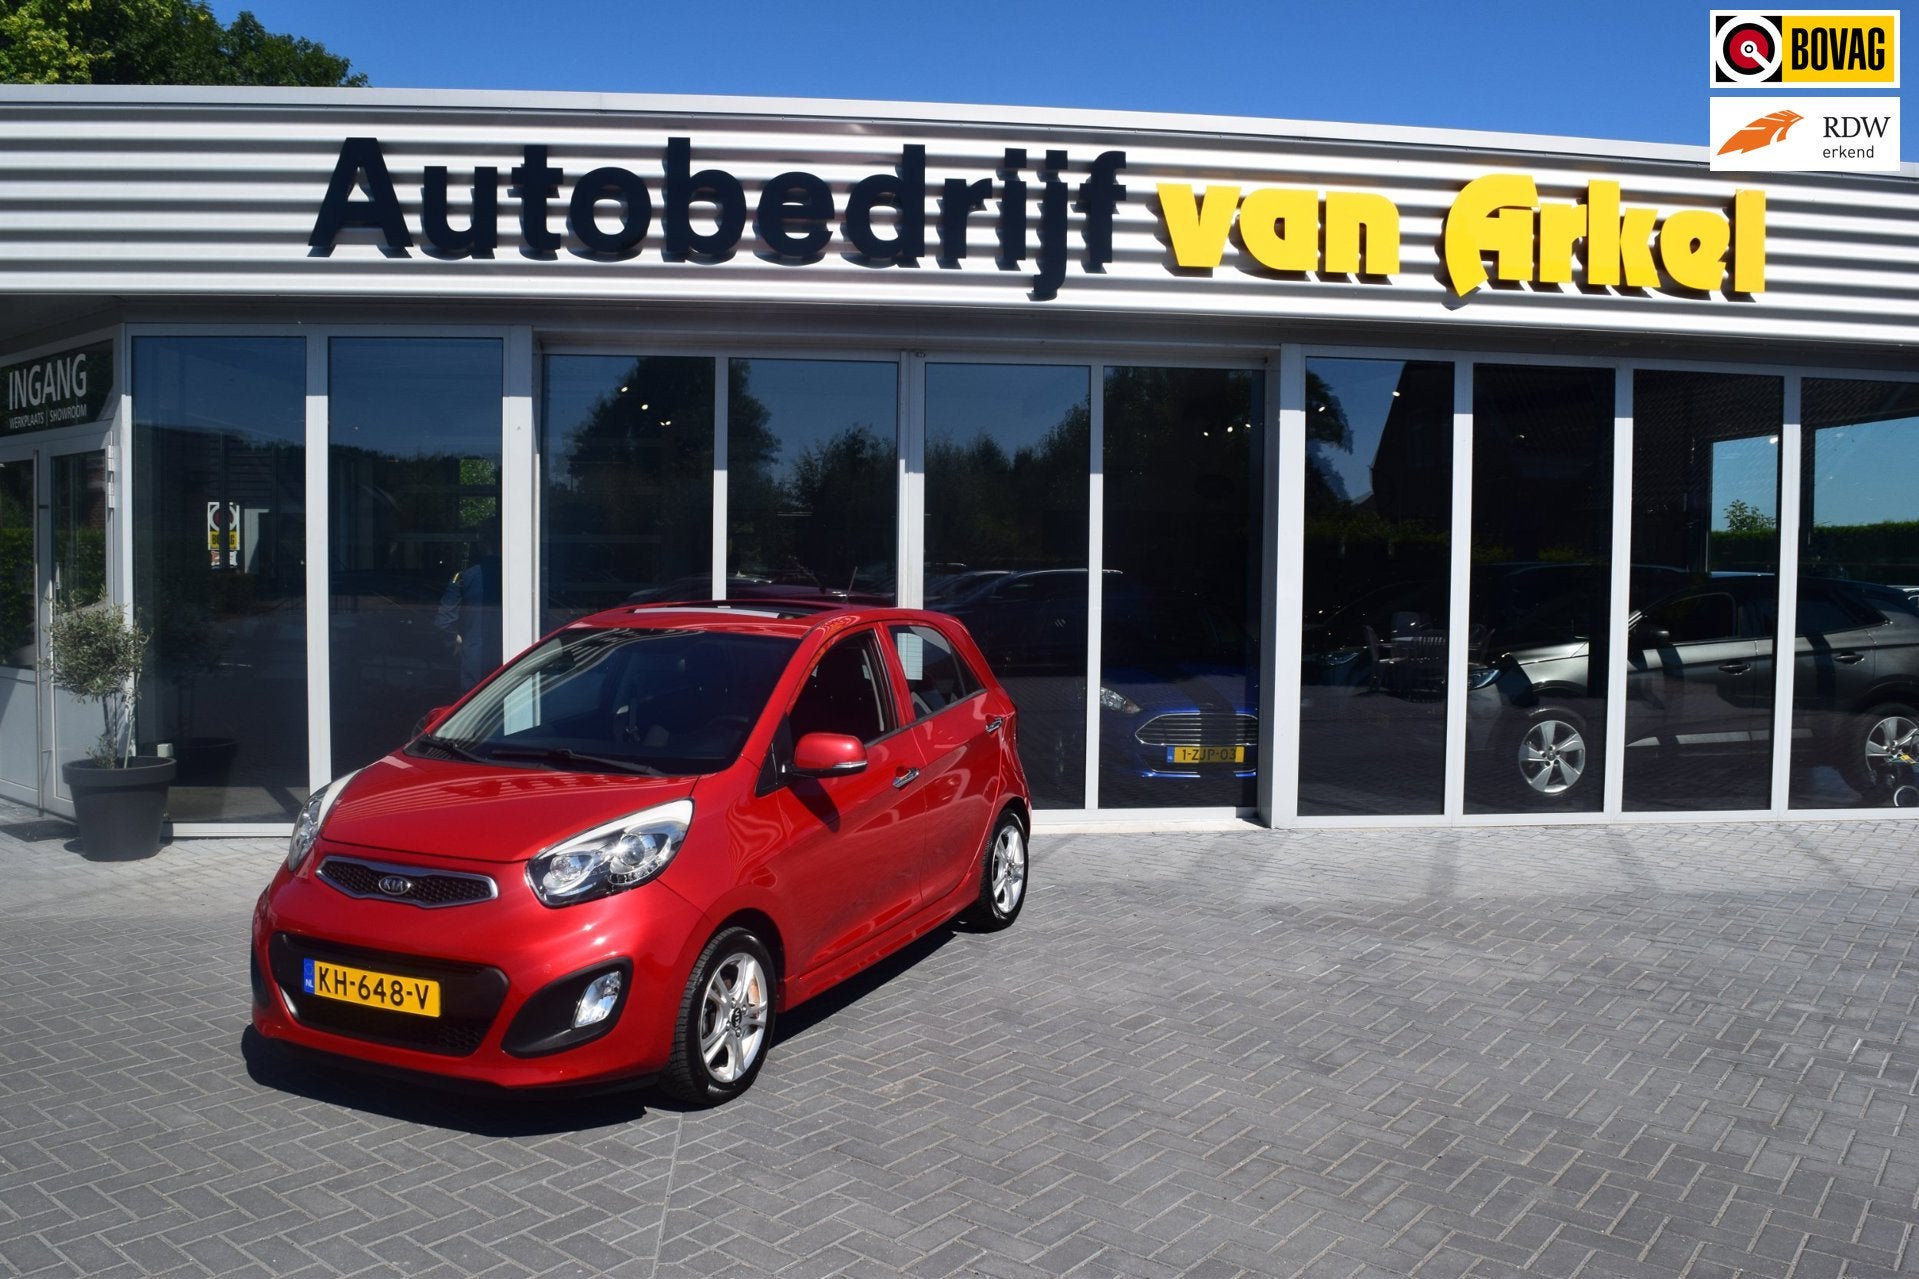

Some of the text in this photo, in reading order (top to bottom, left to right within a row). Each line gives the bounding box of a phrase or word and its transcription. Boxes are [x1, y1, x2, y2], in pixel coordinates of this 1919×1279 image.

[307, 137, 1767, 300] Autobedrijf van Arkel
[9, 353, 87, 411] INGANG
[9, 404, 87, 429] WERKPLAATS SHOWROOM
[1182, 748, 1236, 761] 1-ZJP-03
[383, 879, 404, 891] KIA
[305, 965, 430, 1010] NL KH-648-V
